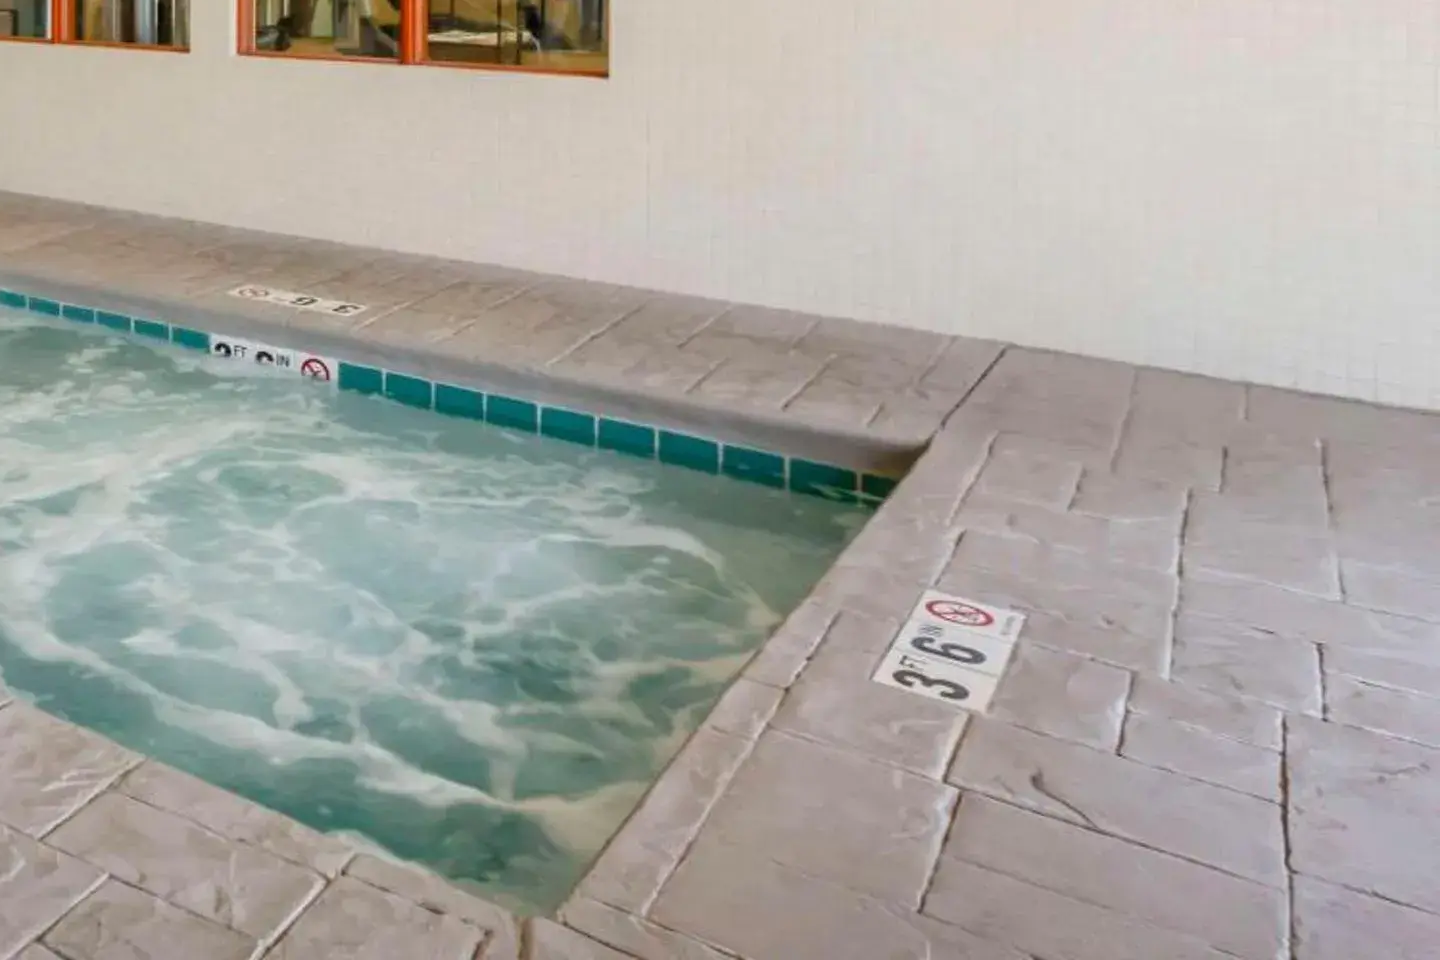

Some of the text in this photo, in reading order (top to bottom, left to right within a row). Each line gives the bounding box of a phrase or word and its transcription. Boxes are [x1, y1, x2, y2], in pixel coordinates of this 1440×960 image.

[233, 344, 248, 358] FT
[275, 353, 290, 368] IN
[911, 636, 987, 665] 6
[892, 669, 970, 700] 3
